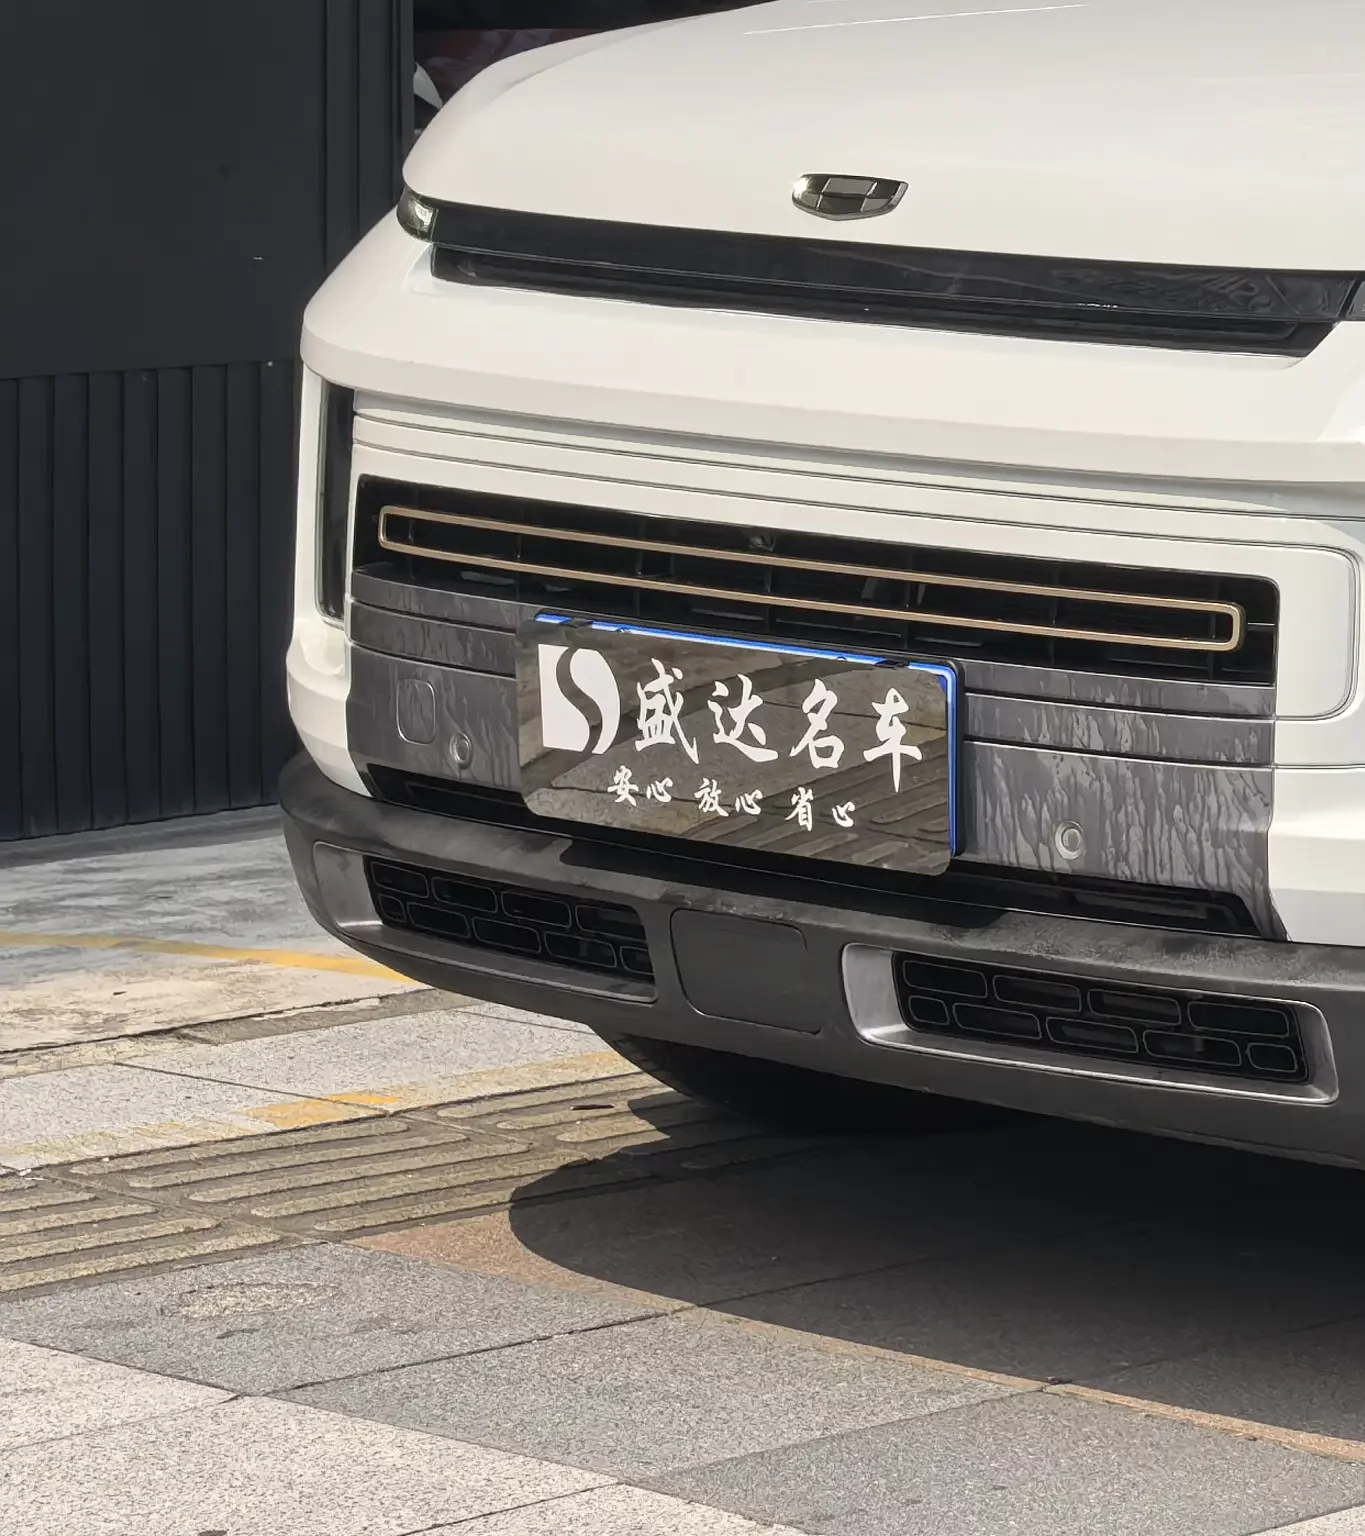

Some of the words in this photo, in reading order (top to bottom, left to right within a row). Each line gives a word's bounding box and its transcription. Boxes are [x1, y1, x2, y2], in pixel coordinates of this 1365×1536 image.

[635, 657, 924, 794] 盛达名车
[606, 764, 674, 807] 安心
[693, 777, 764, 818] 放心
[784, 786, 857, 833] 省心
